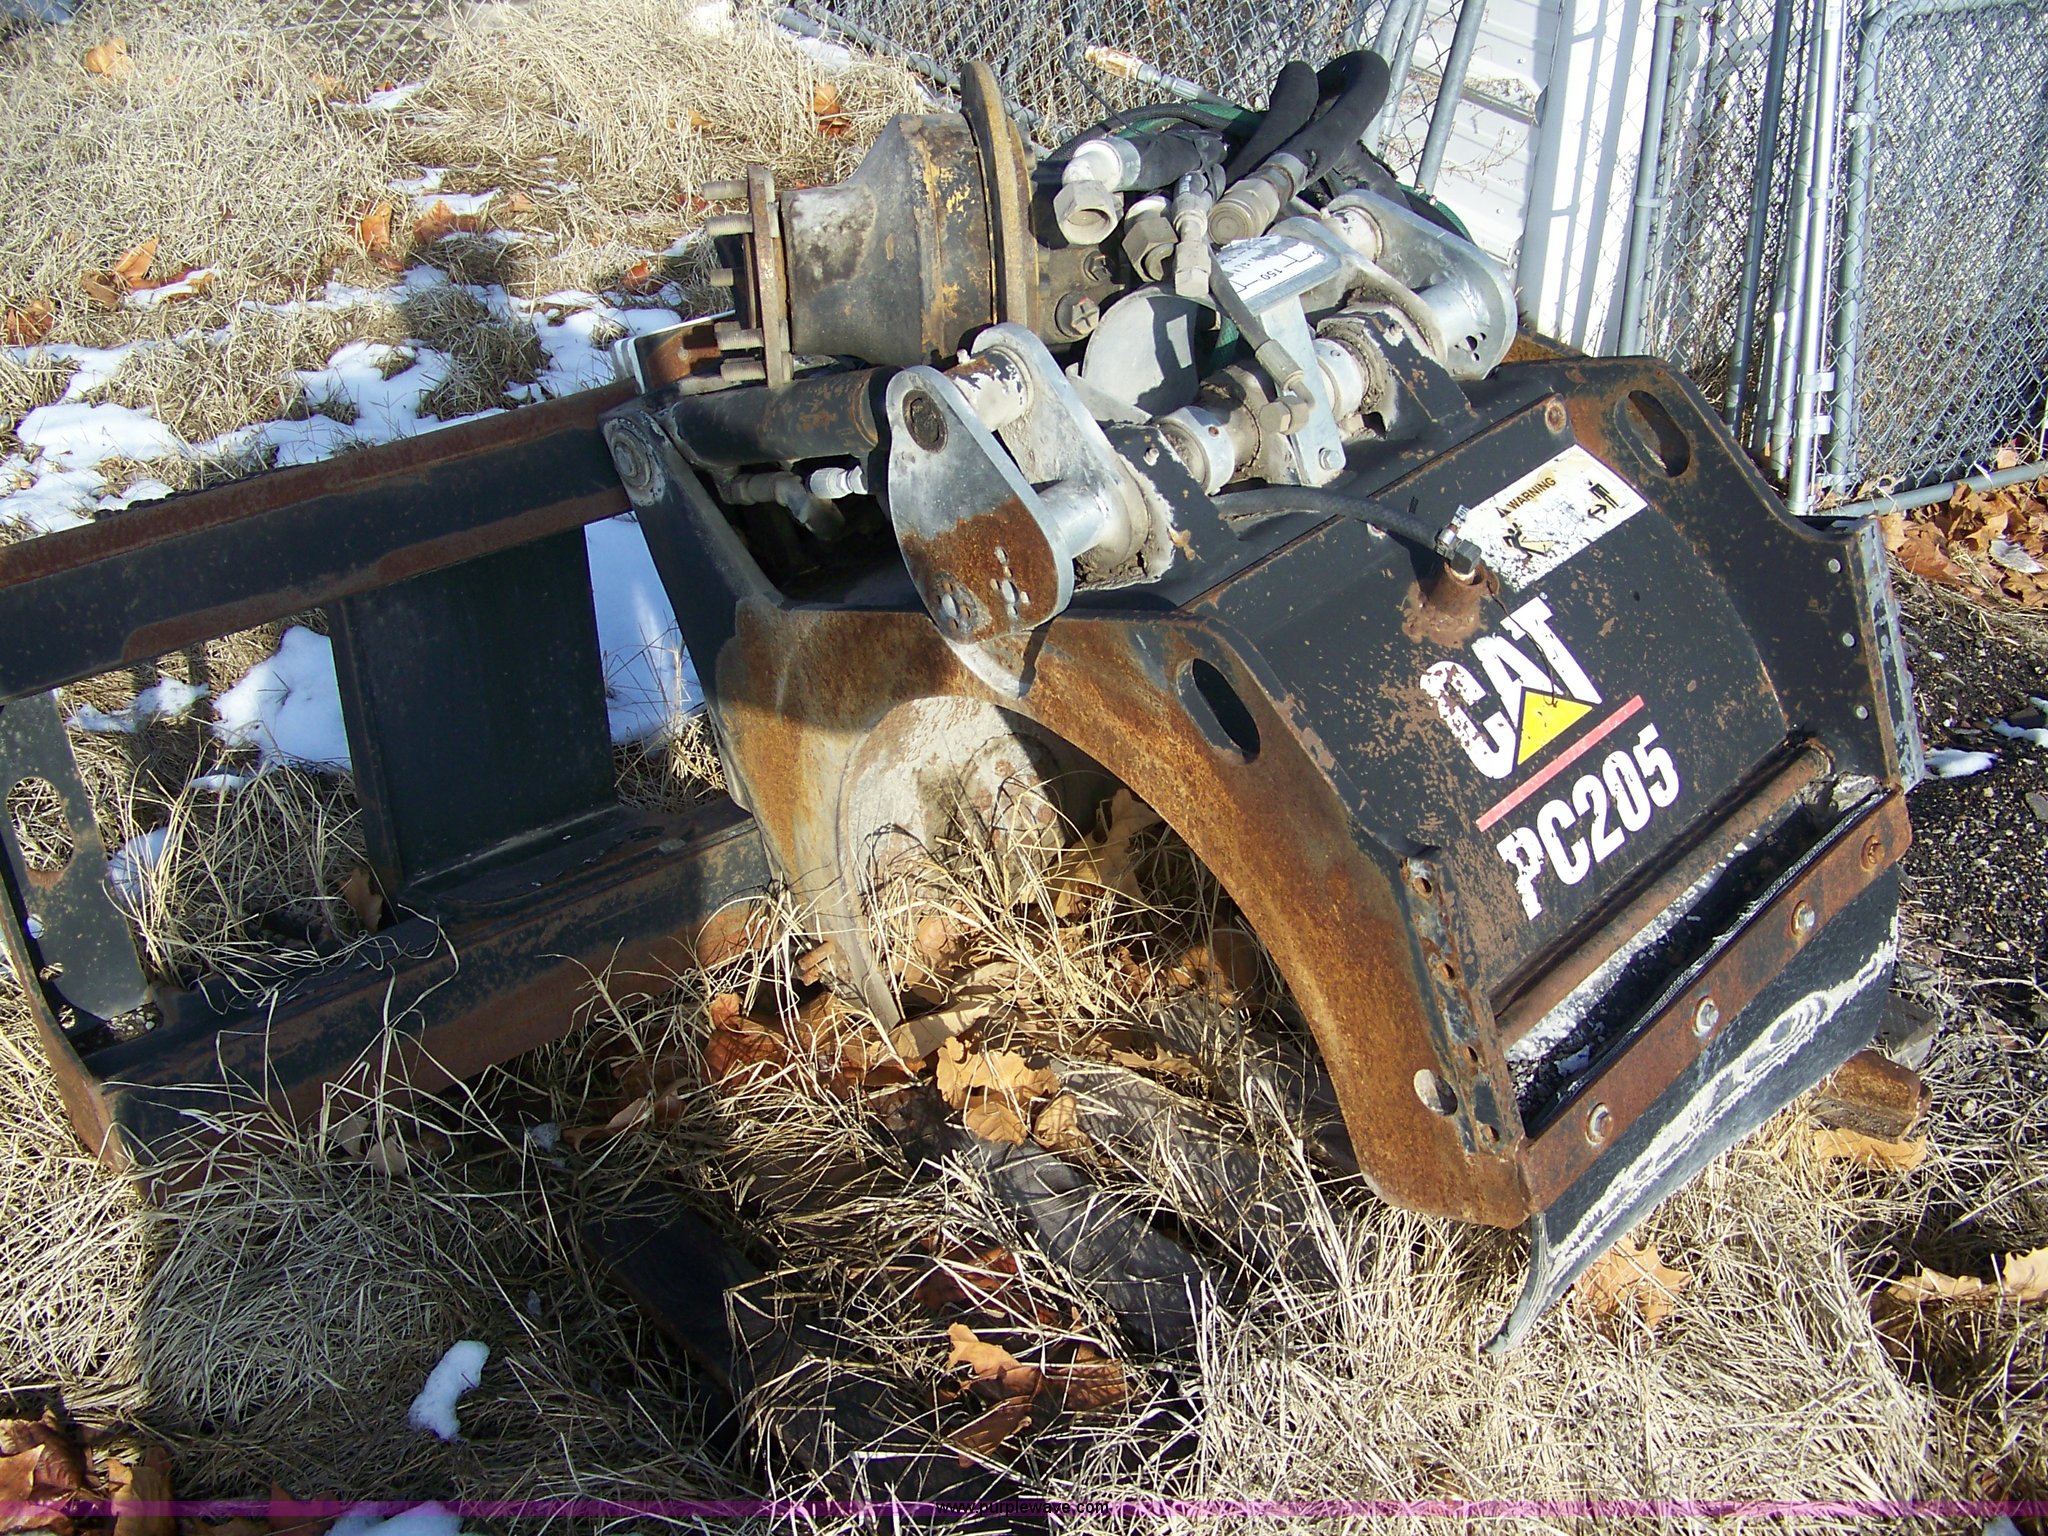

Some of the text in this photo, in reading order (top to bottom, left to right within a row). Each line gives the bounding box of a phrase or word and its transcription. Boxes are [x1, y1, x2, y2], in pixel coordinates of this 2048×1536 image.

[1260, 268, 1283, 280] 150
[1507, 477, 1557, 510] WARNING
[1419, 595, 1602, 780] CAT
[1496, 723, 1680, 922] PC205
